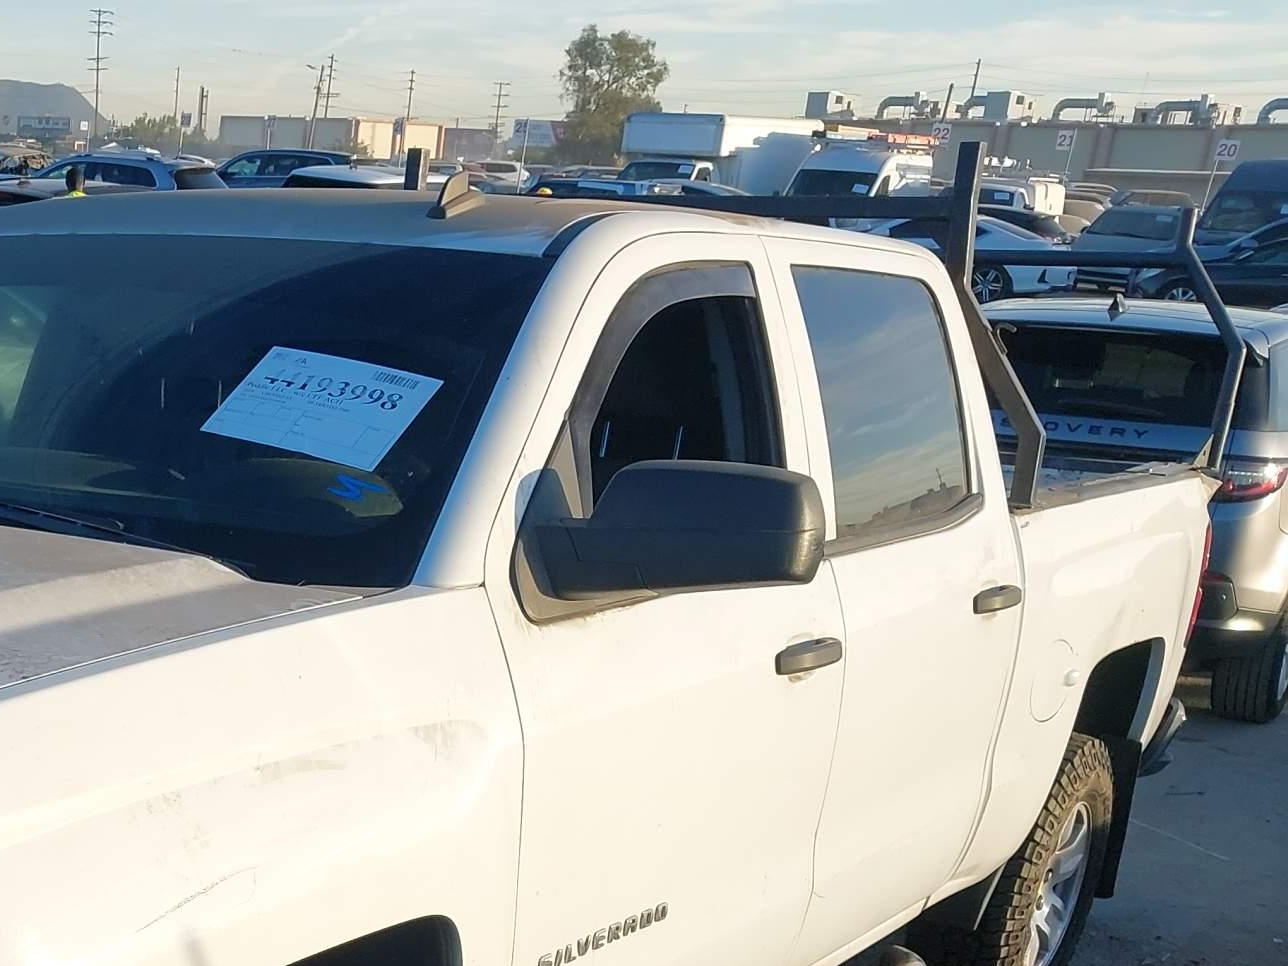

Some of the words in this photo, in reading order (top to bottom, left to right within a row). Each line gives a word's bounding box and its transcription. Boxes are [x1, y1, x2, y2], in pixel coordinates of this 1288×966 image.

[934, 127, 950, 140] 22
[1057, 134, 1073, 147] 21
[1216, 143, 1237, 157] 20
